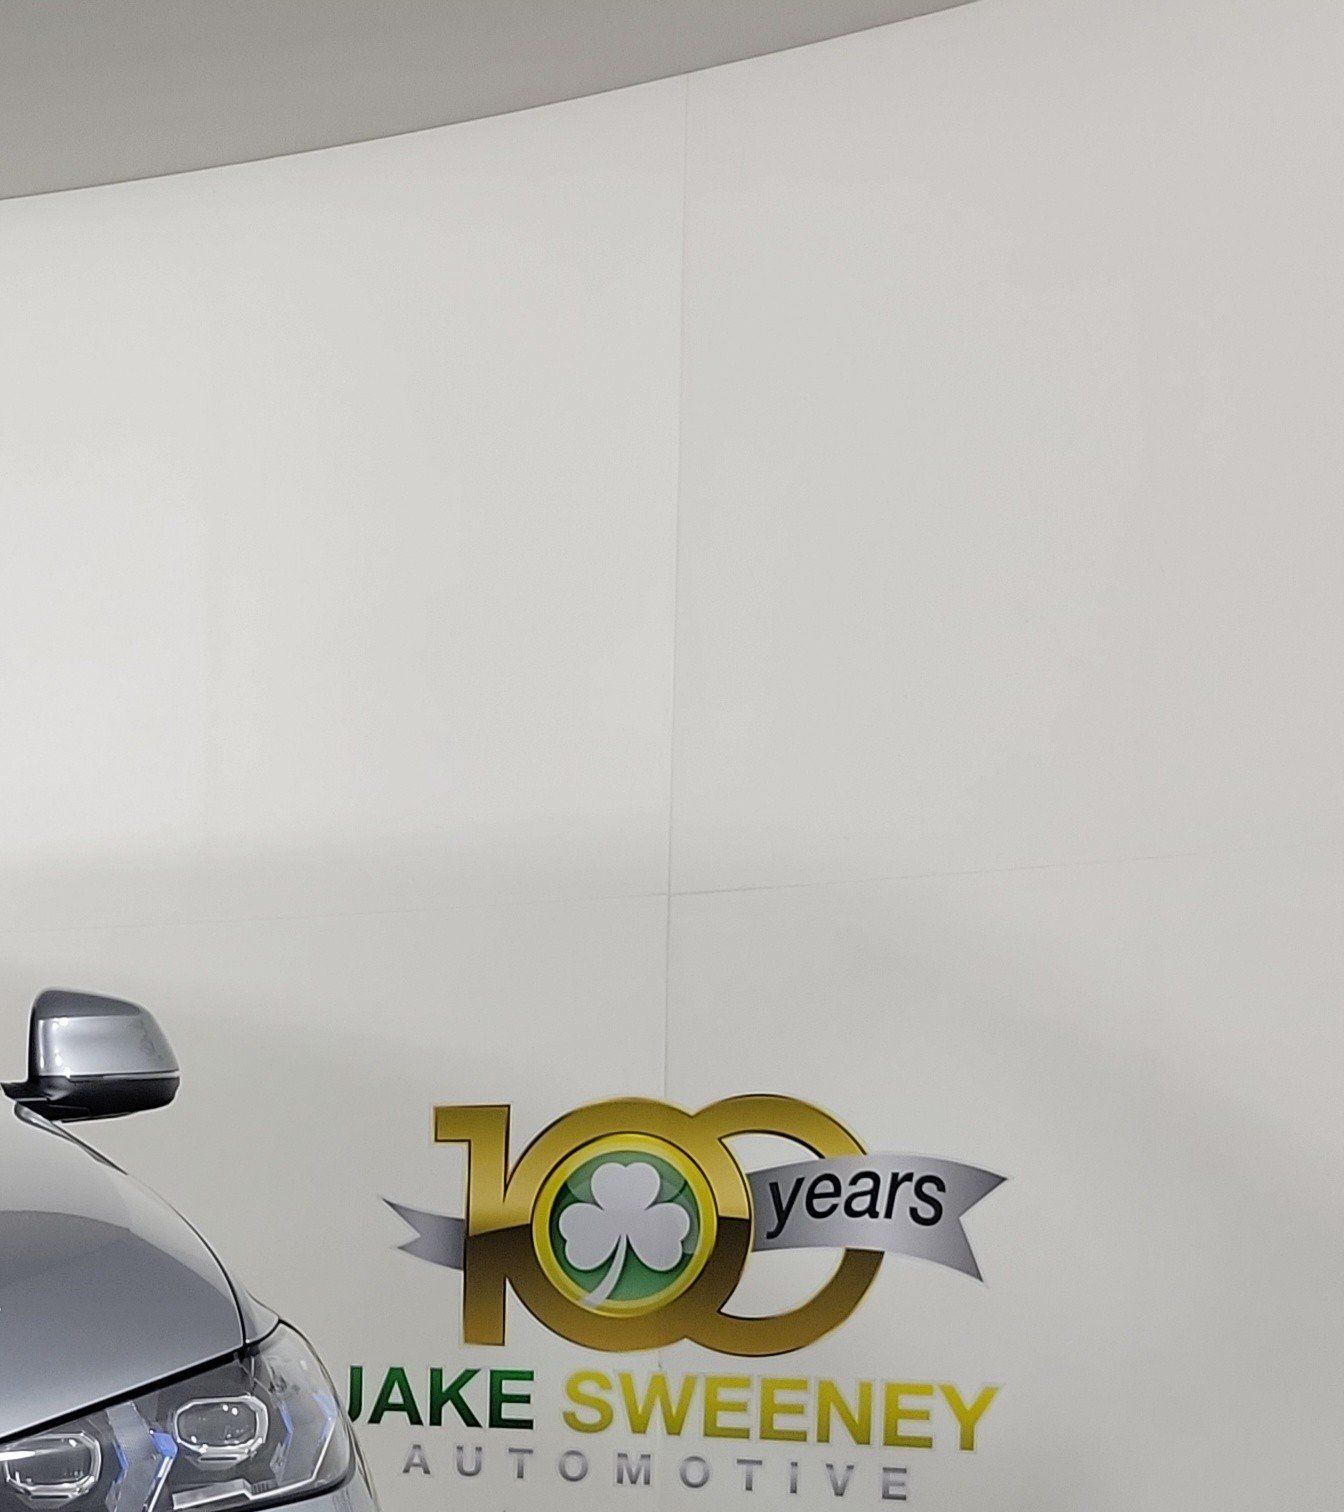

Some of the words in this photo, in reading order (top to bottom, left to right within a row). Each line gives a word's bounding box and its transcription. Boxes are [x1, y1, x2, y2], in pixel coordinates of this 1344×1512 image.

[433, 1094, 885, 1357] 100
[766, 1171, 946, 1239] years
[348, 1365, 535, 1430] JAKE
[562, 1369, 999, 1452] SWEENEY
[402, 1443, 909, 1501] AUTOMOTIVE
